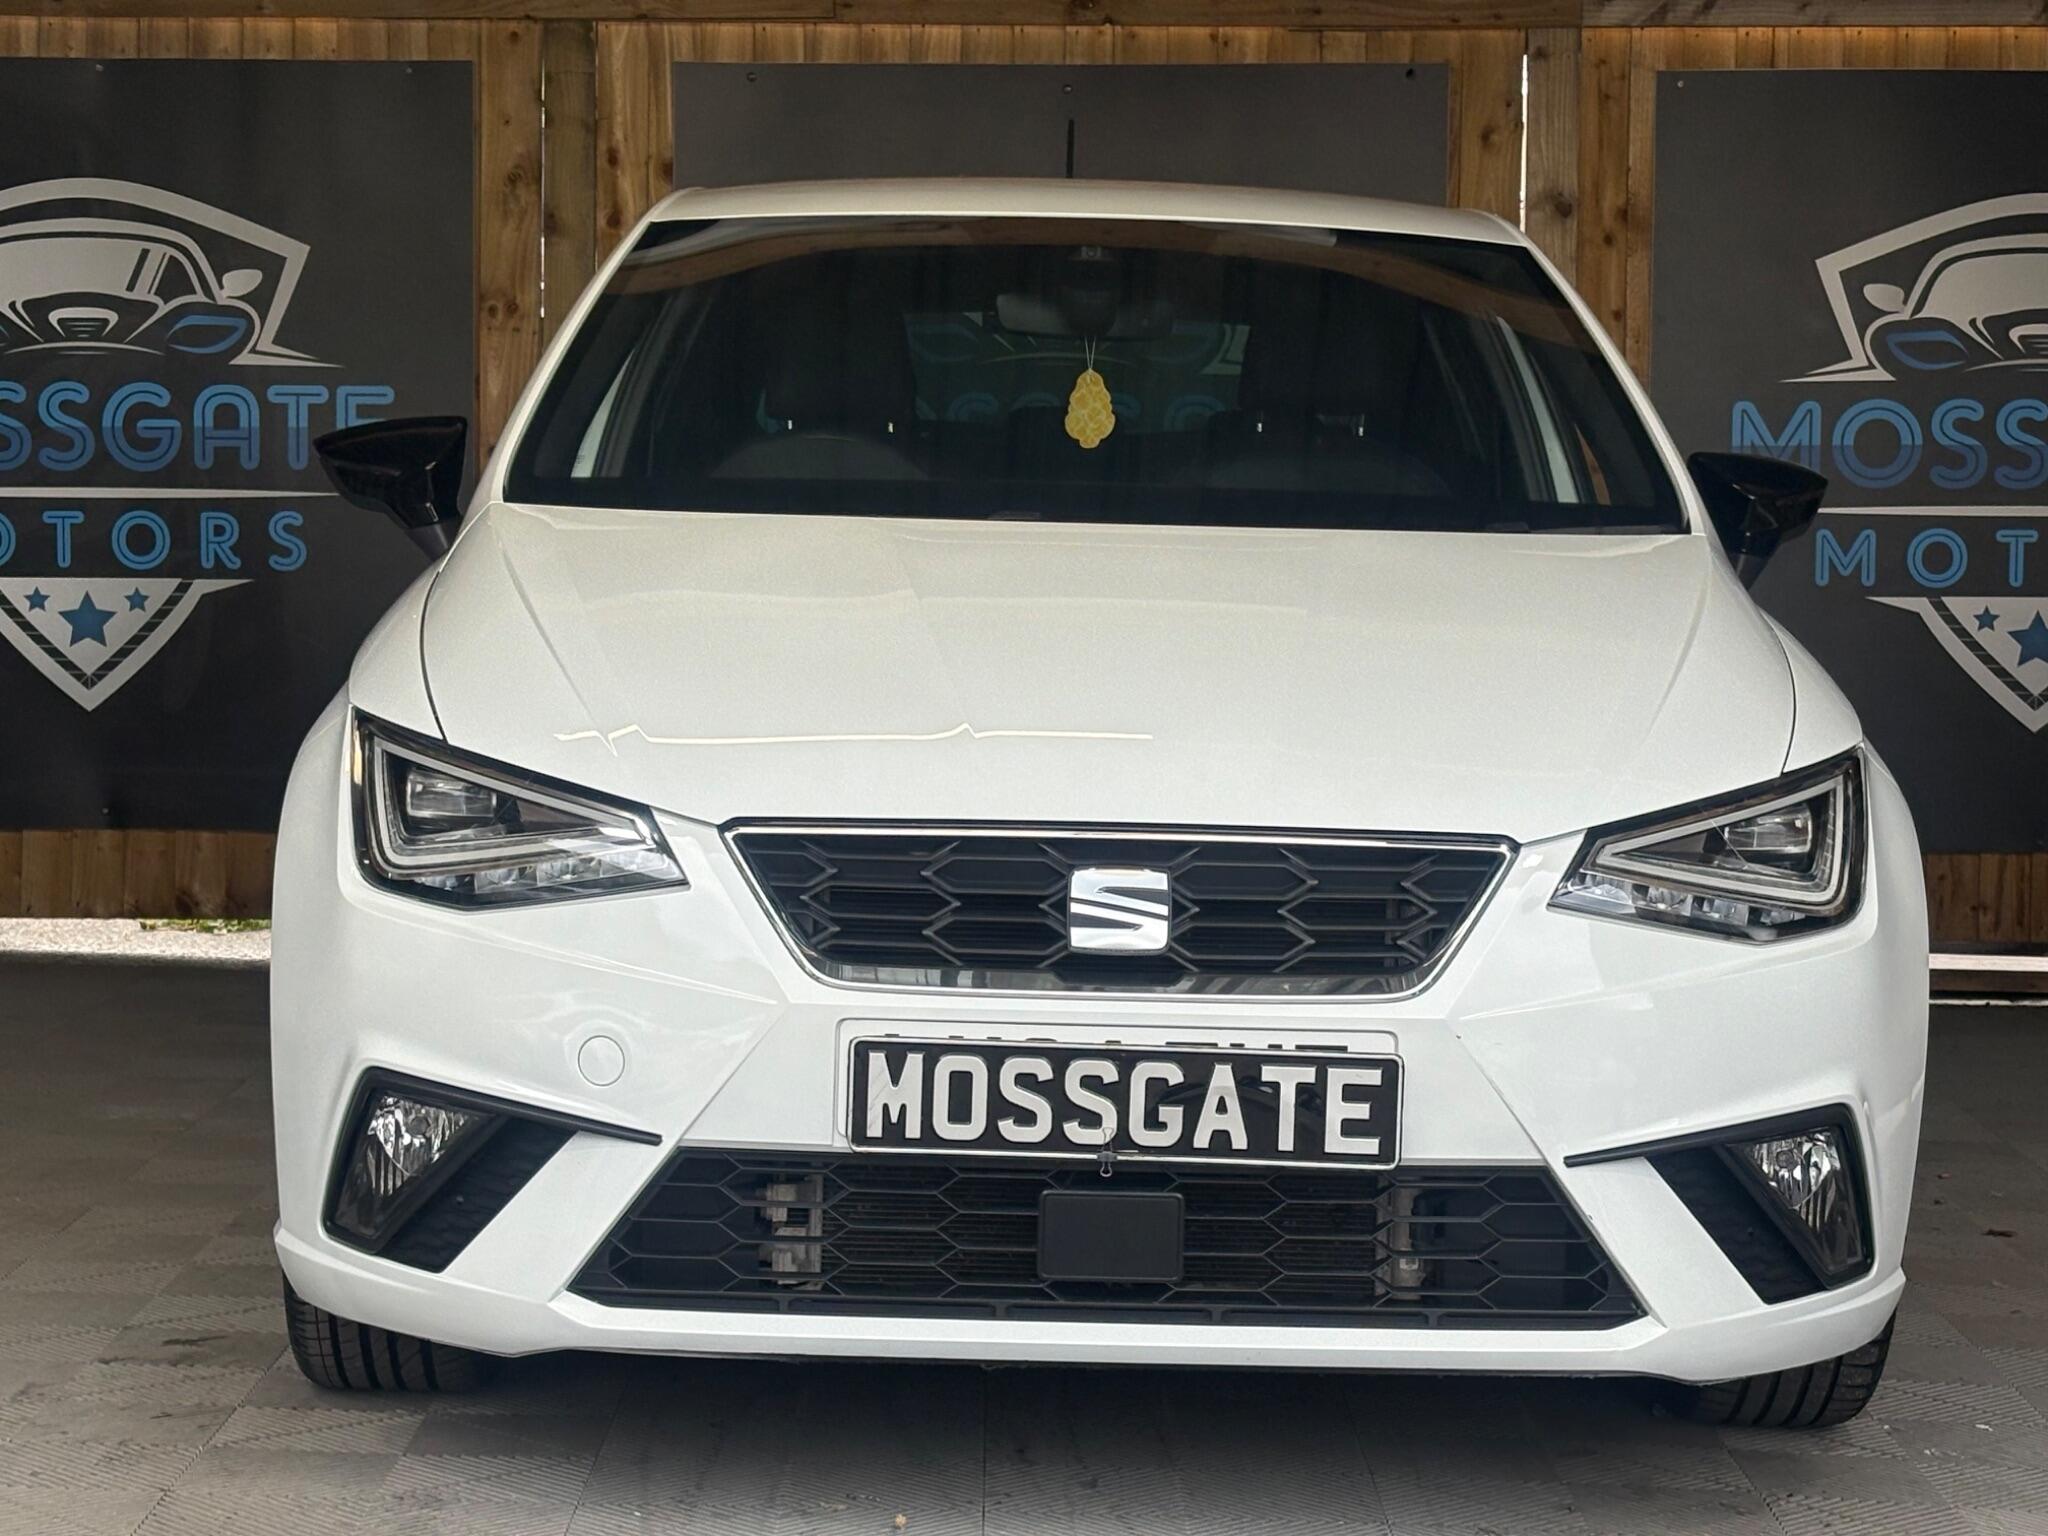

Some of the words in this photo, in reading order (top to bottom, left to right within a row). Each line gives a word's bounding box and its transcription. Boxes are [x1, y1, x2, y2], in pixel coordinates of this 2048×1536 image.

[0, 510, 307, 571] TORS
[1815, 528, 2039, 589] MOT
[866, 1050, 1383, 1154] MOSSGATE
